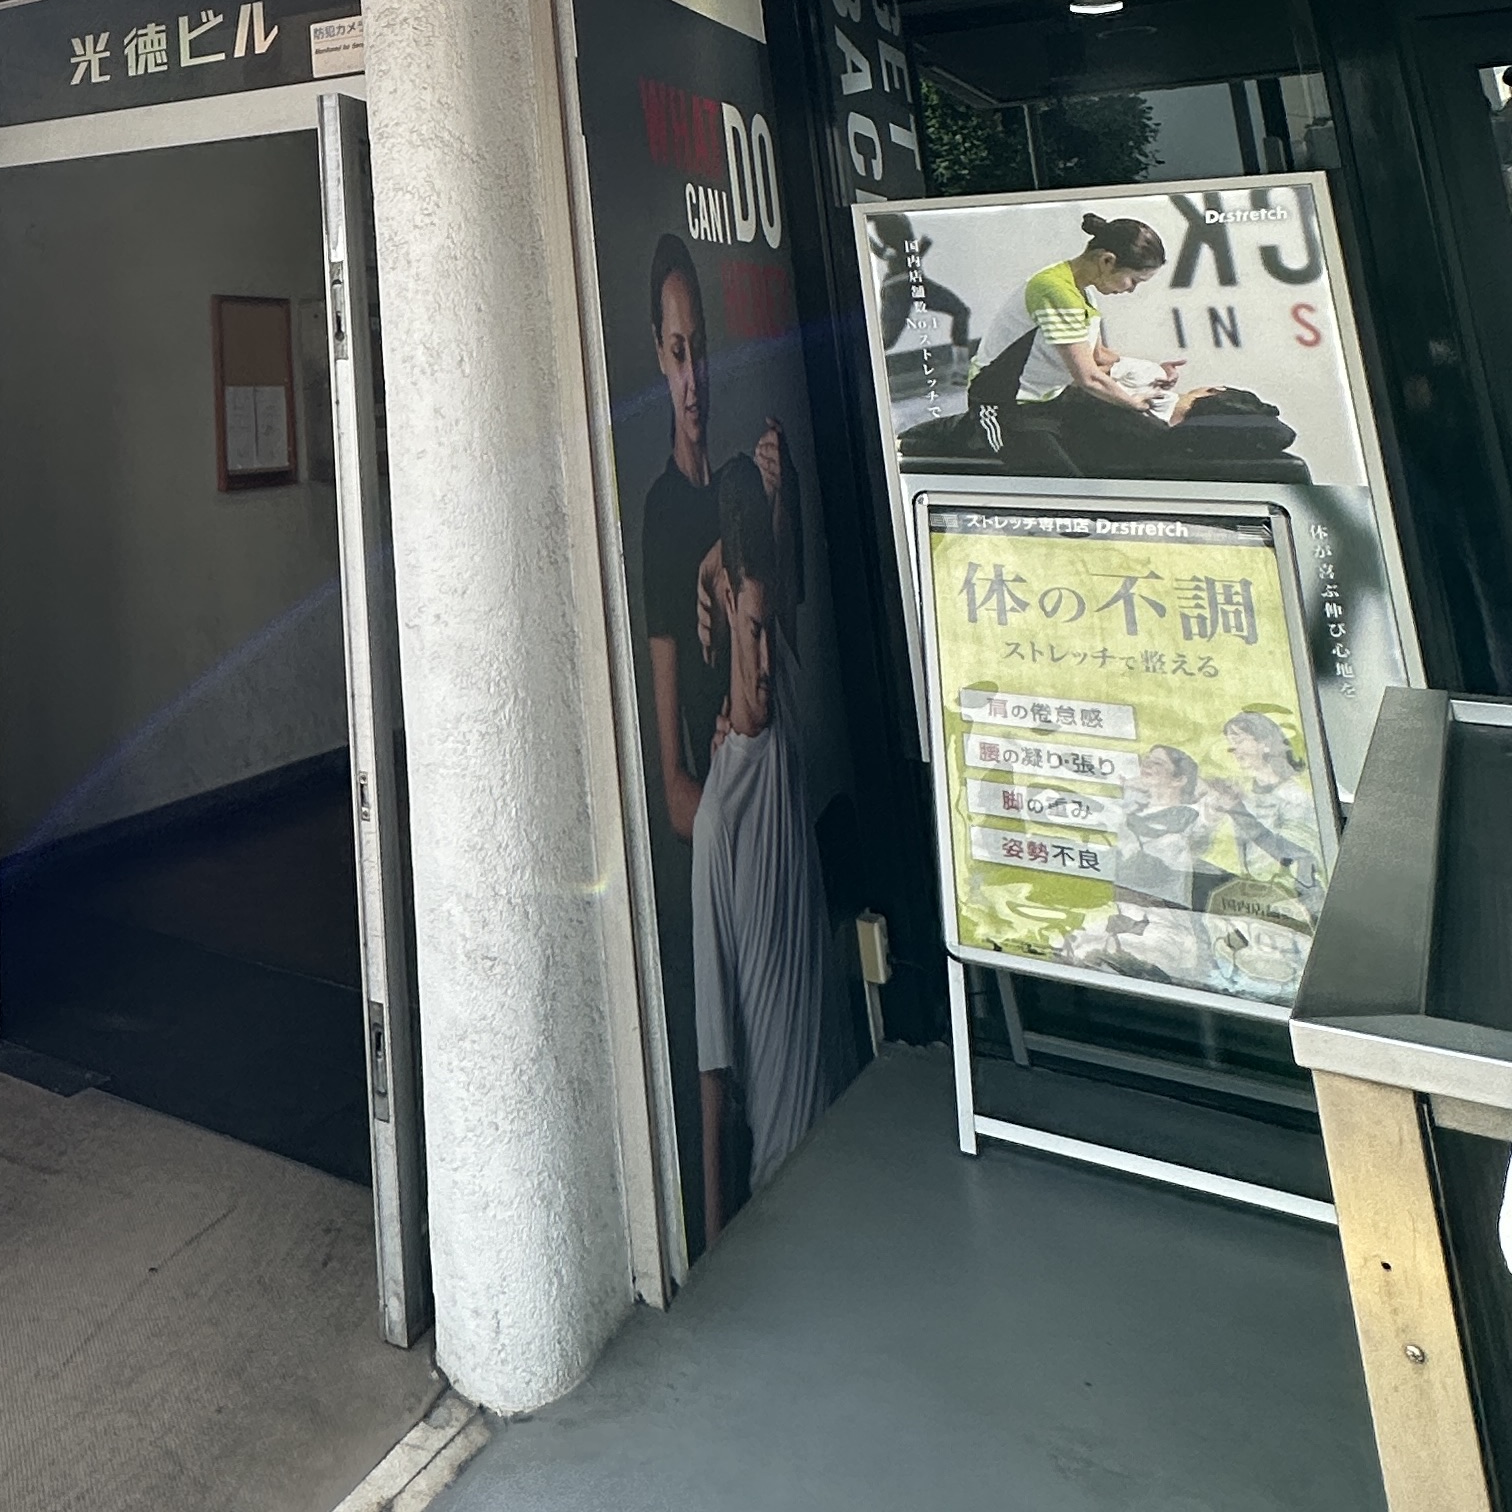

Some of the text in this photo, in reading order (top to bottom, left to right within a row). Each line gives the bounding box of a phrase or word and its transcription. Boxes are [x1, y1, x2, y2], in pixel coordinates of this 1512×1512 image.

[70, 1, 279, 86] 光徳ビル
[722, 101, 782, 250] DO
[685, 182, 724, 244] CAN
[966, 513, 1089, 533] ストレッチ専門店
[958, 561, 1260, 646] 体の不調
[1003, 639, 1222, 679] ストレッチで整える
[986, 697, 1104, 729] 肩の倦怠感
[1001, 836, 1102, 873] 姿勢不良
